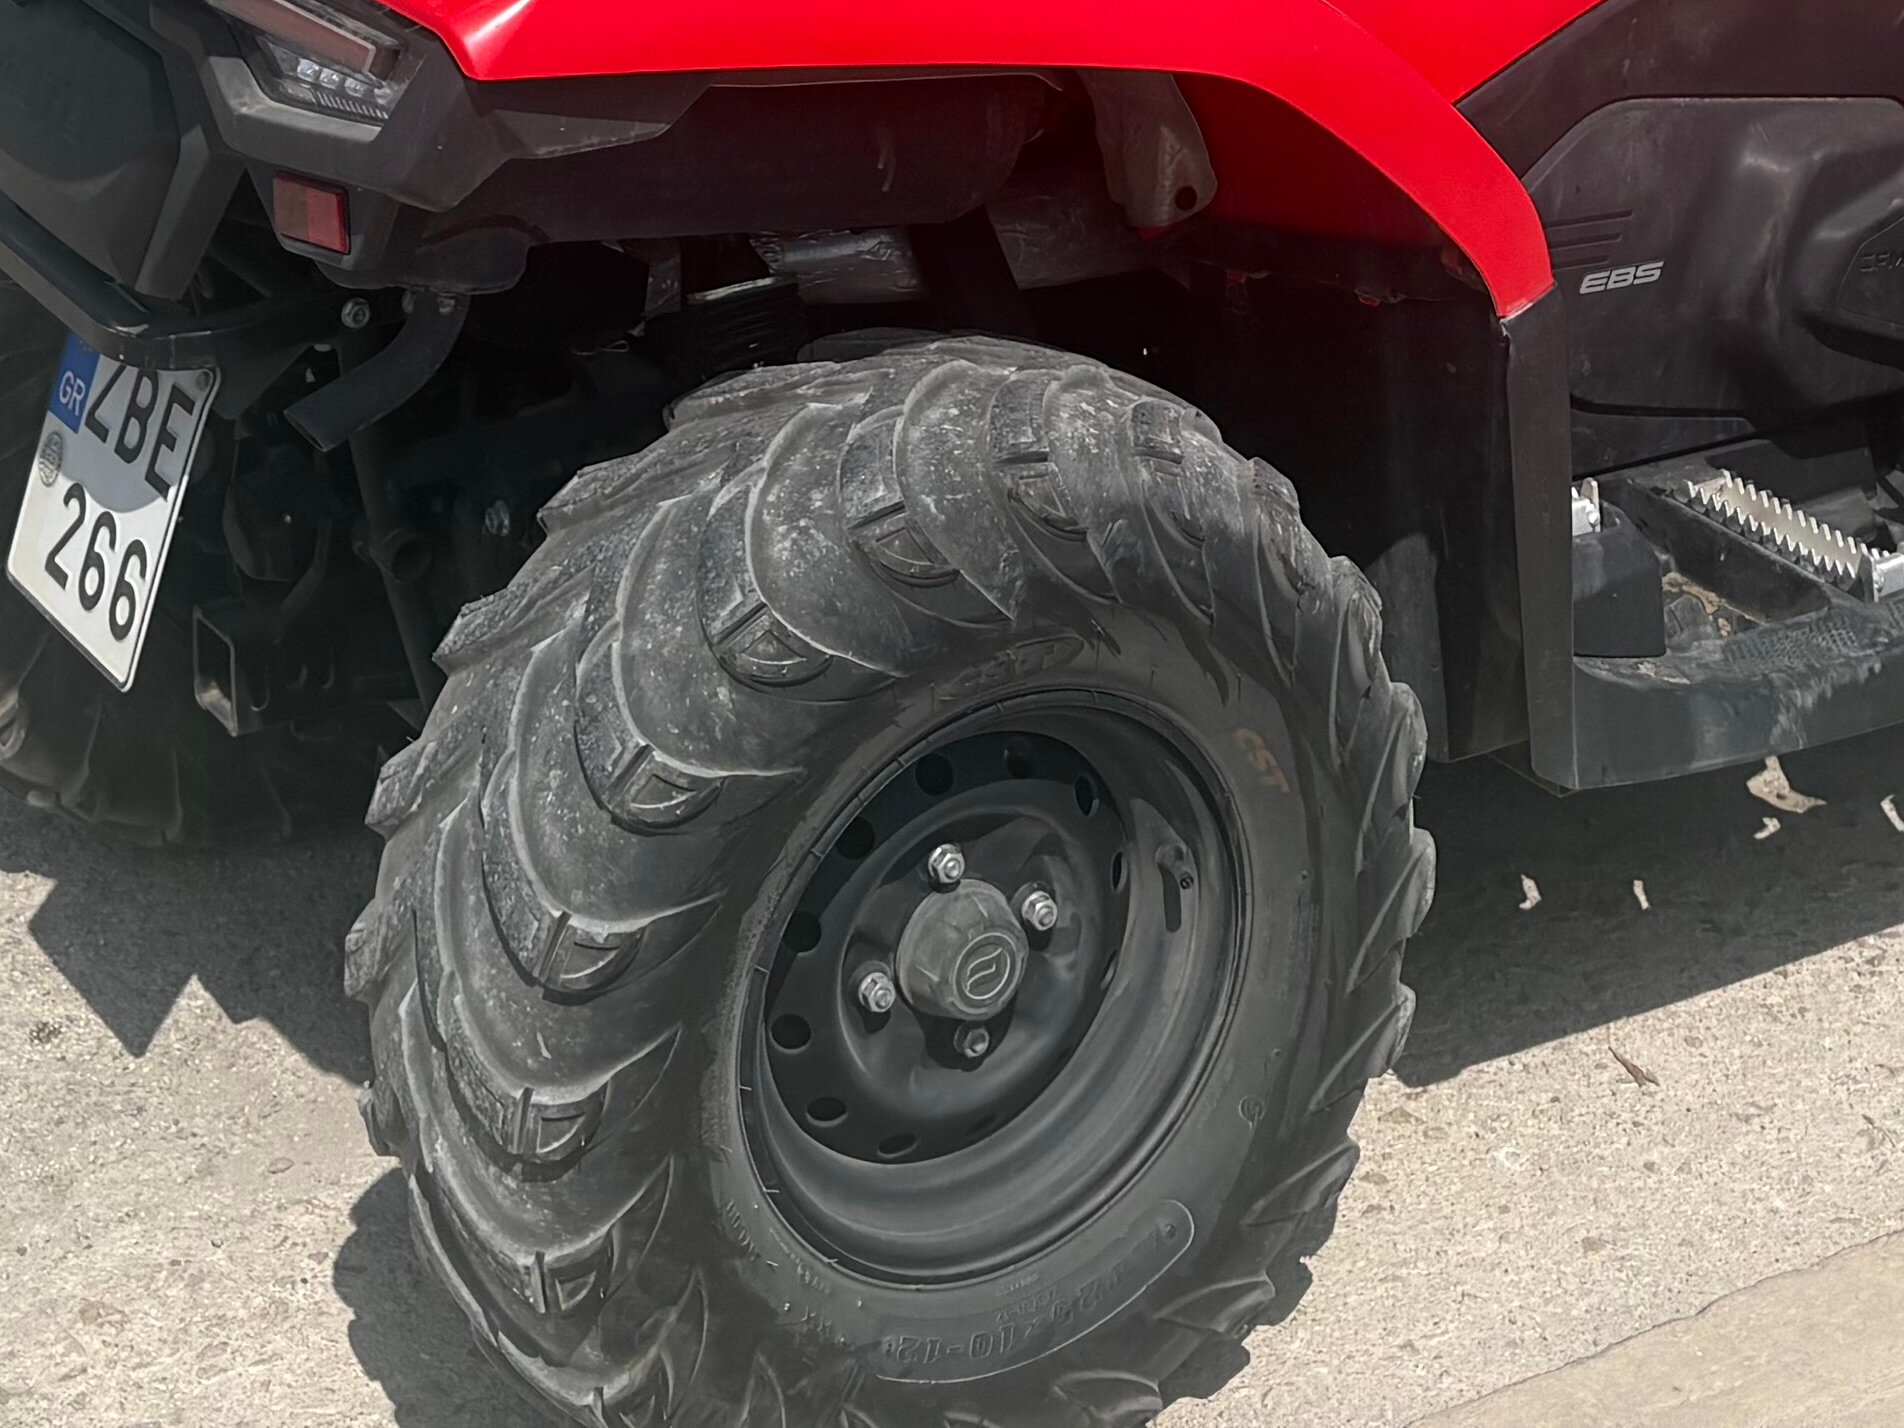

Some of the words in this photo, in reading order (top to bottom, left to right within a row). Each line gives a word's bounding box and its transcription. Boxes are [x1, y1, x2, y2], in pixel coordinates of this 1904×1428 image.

[1579, 261, 1665, 295] EBS
[58, 370, 86, 417] GR
[43, 482, 148, 643] 266
[1233, 727, 1290, 793] CST
